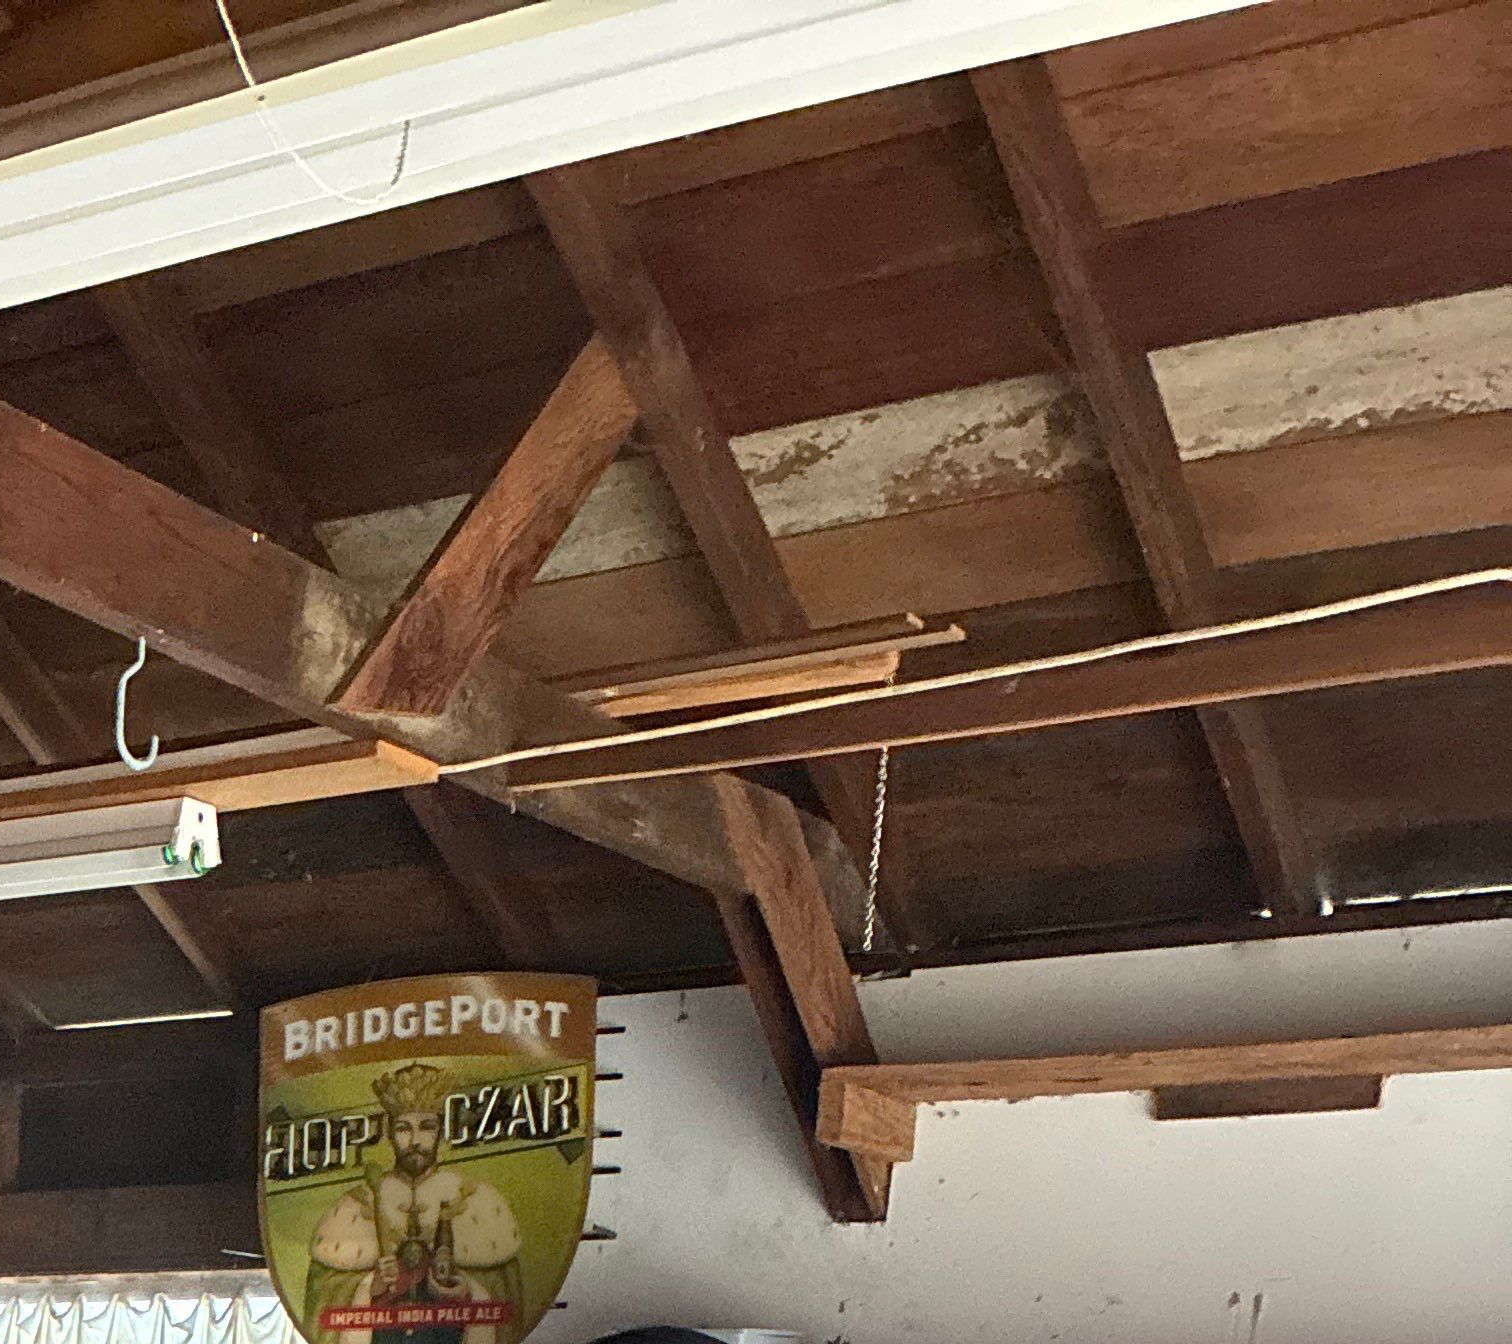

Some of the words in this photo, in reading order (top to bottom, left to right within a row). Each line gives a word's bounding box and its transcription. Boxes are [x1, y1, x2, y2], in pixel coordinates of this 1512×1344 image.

[283, 994, 570, 1061] BRIDGEPORT
[264, 1114, 375, 1180] HOP
[442, 1074, 578, 1146] CZAR
[329, 1308, 394, 1326] IMPERIAL
[397, 1306, 433, 1324] INDIA
[437, 1305, 471, 1323] PALE
[475, 1304, 502, 1322] ALE
